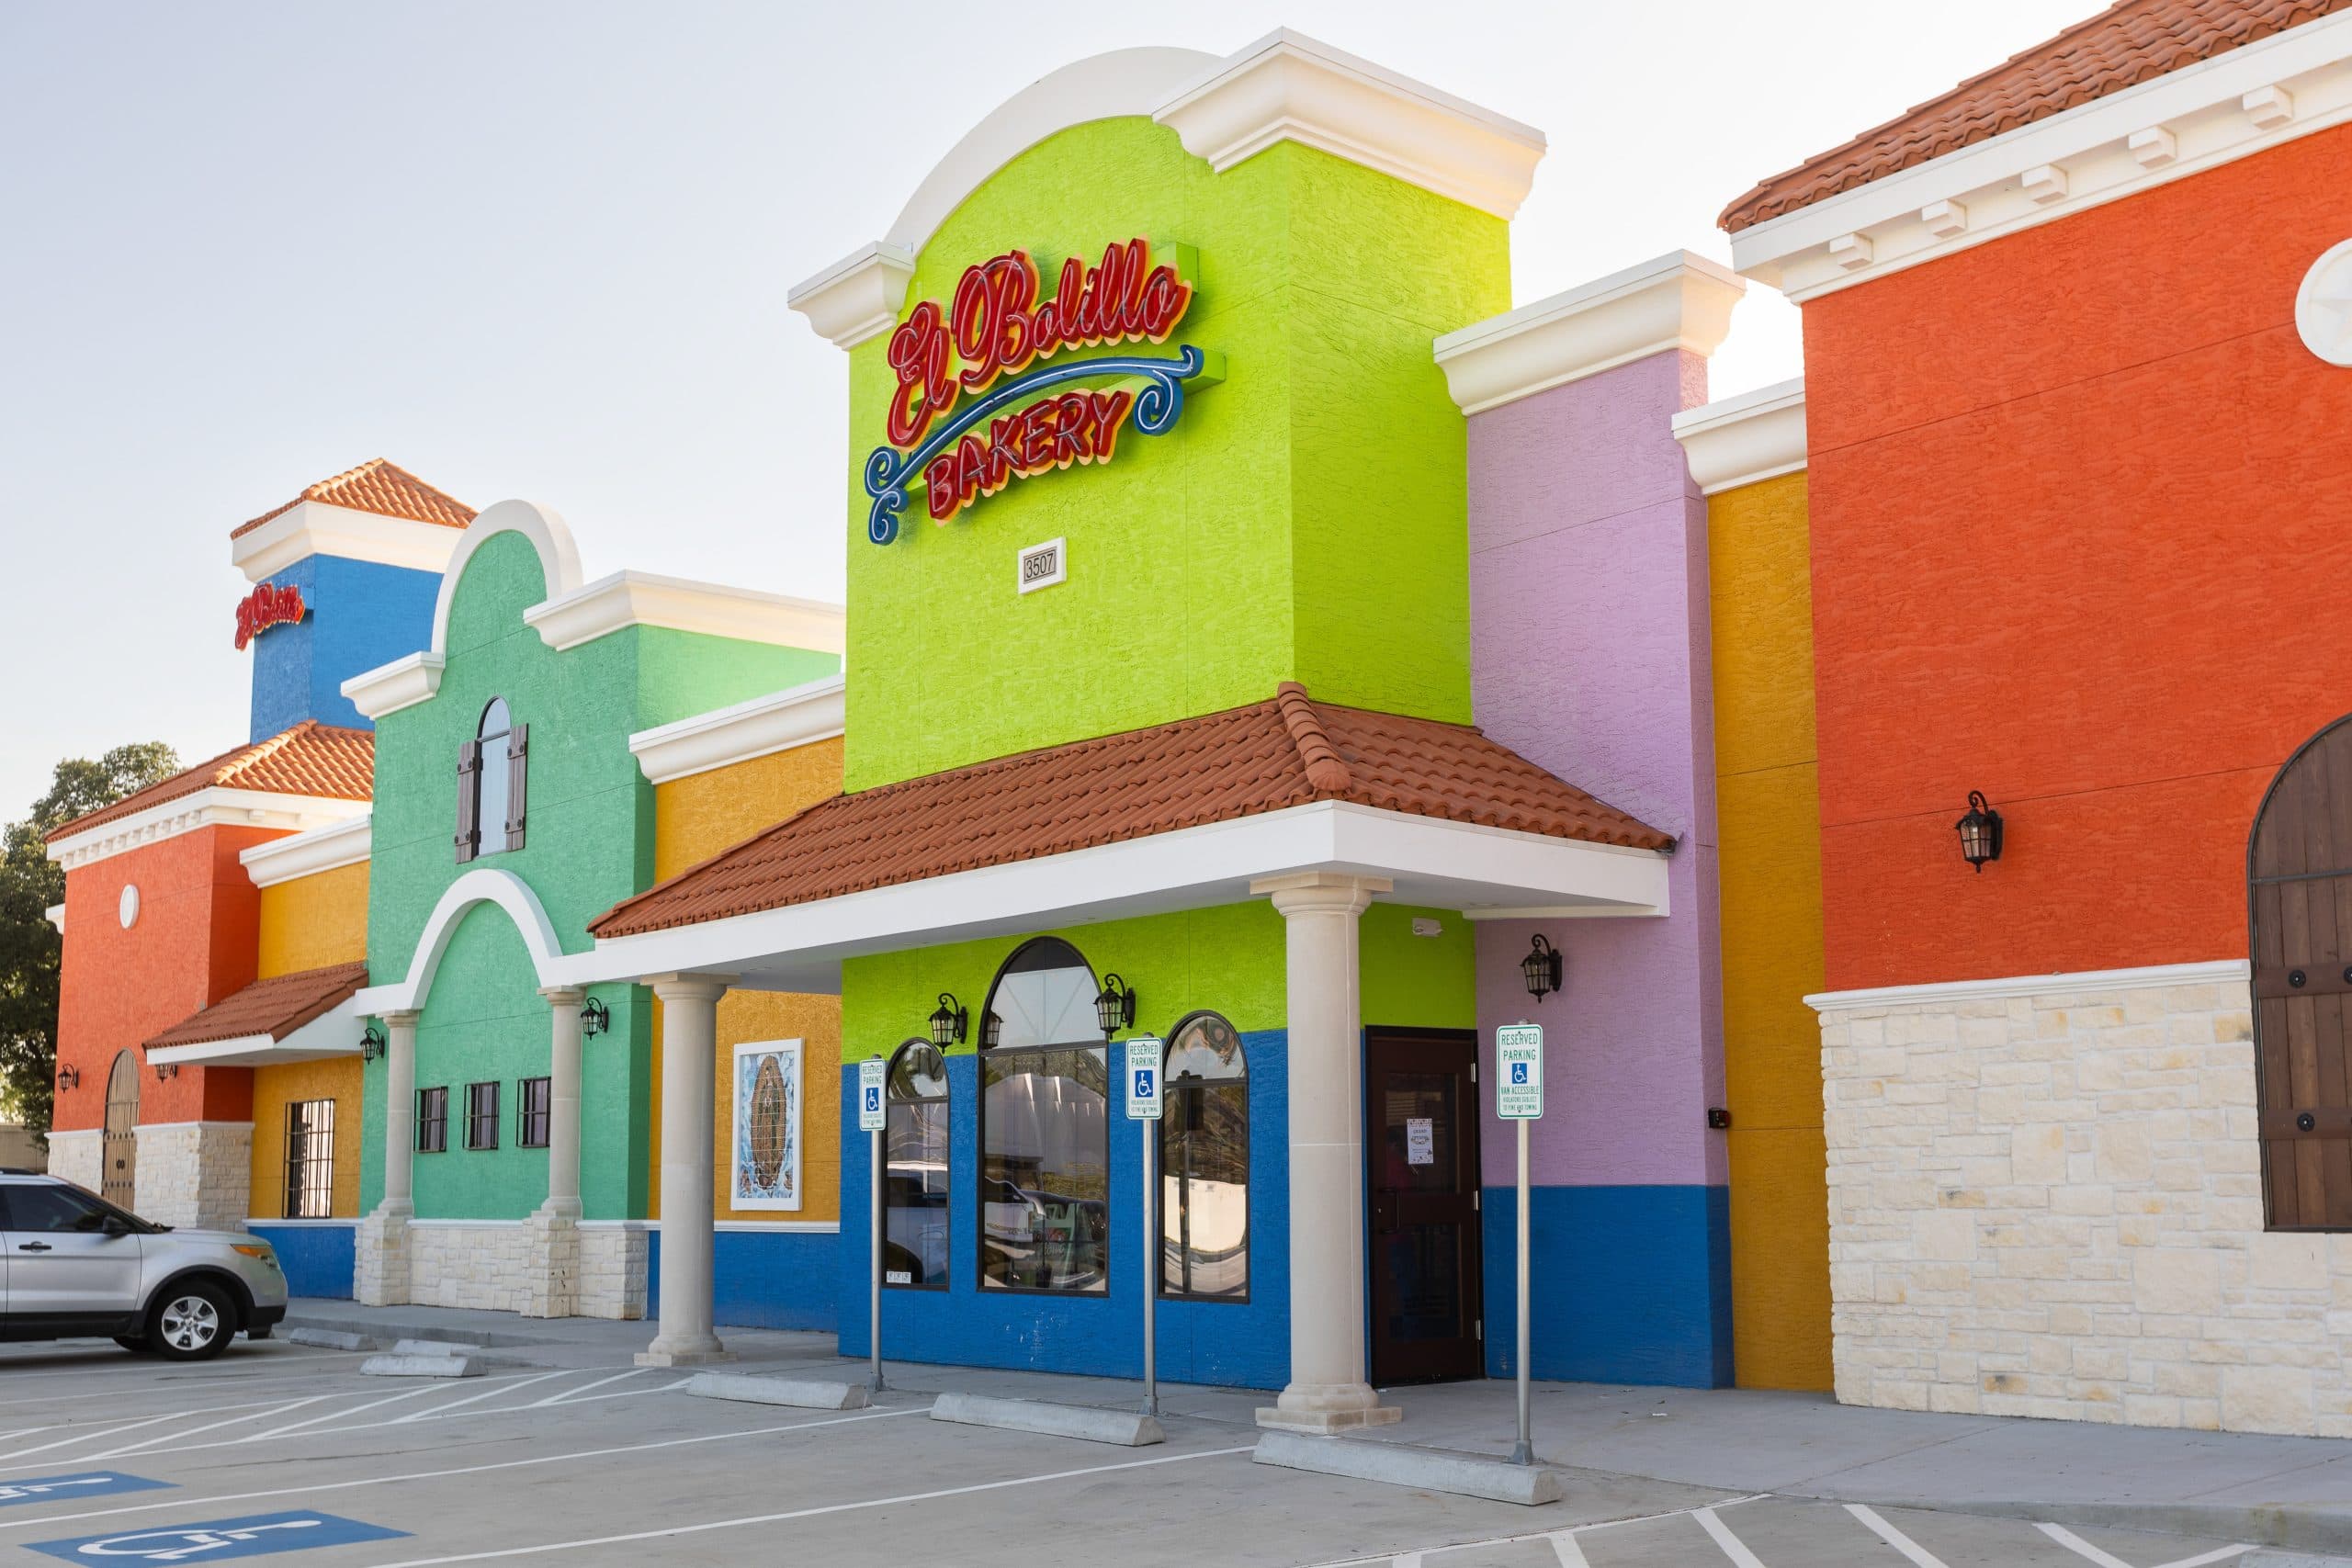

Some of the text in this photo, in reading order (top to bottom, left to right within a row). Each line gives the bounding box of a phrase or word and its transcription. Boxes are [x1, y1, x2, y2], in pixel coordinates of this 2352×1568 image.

[888, 237, 1193, 448] El Bolillo
[923, 389, 1135, 524] BAKERY
[1026, 553, 1054, 578] 3507
[1501, 1033, 1538, 1045] RESERVED
[1130, 1044, 1159, 1055] RESERVED
[1503, 1049, 1536, 1061] PARKING
[1132, 1056, 1157, 1066] PARKING
[863, 1066, 882, 1075] RESERVED
[864, 1075, 882, 1085] PARKING
[1501, 1086, 1539, 1095] VAN ACCESSIBLE
